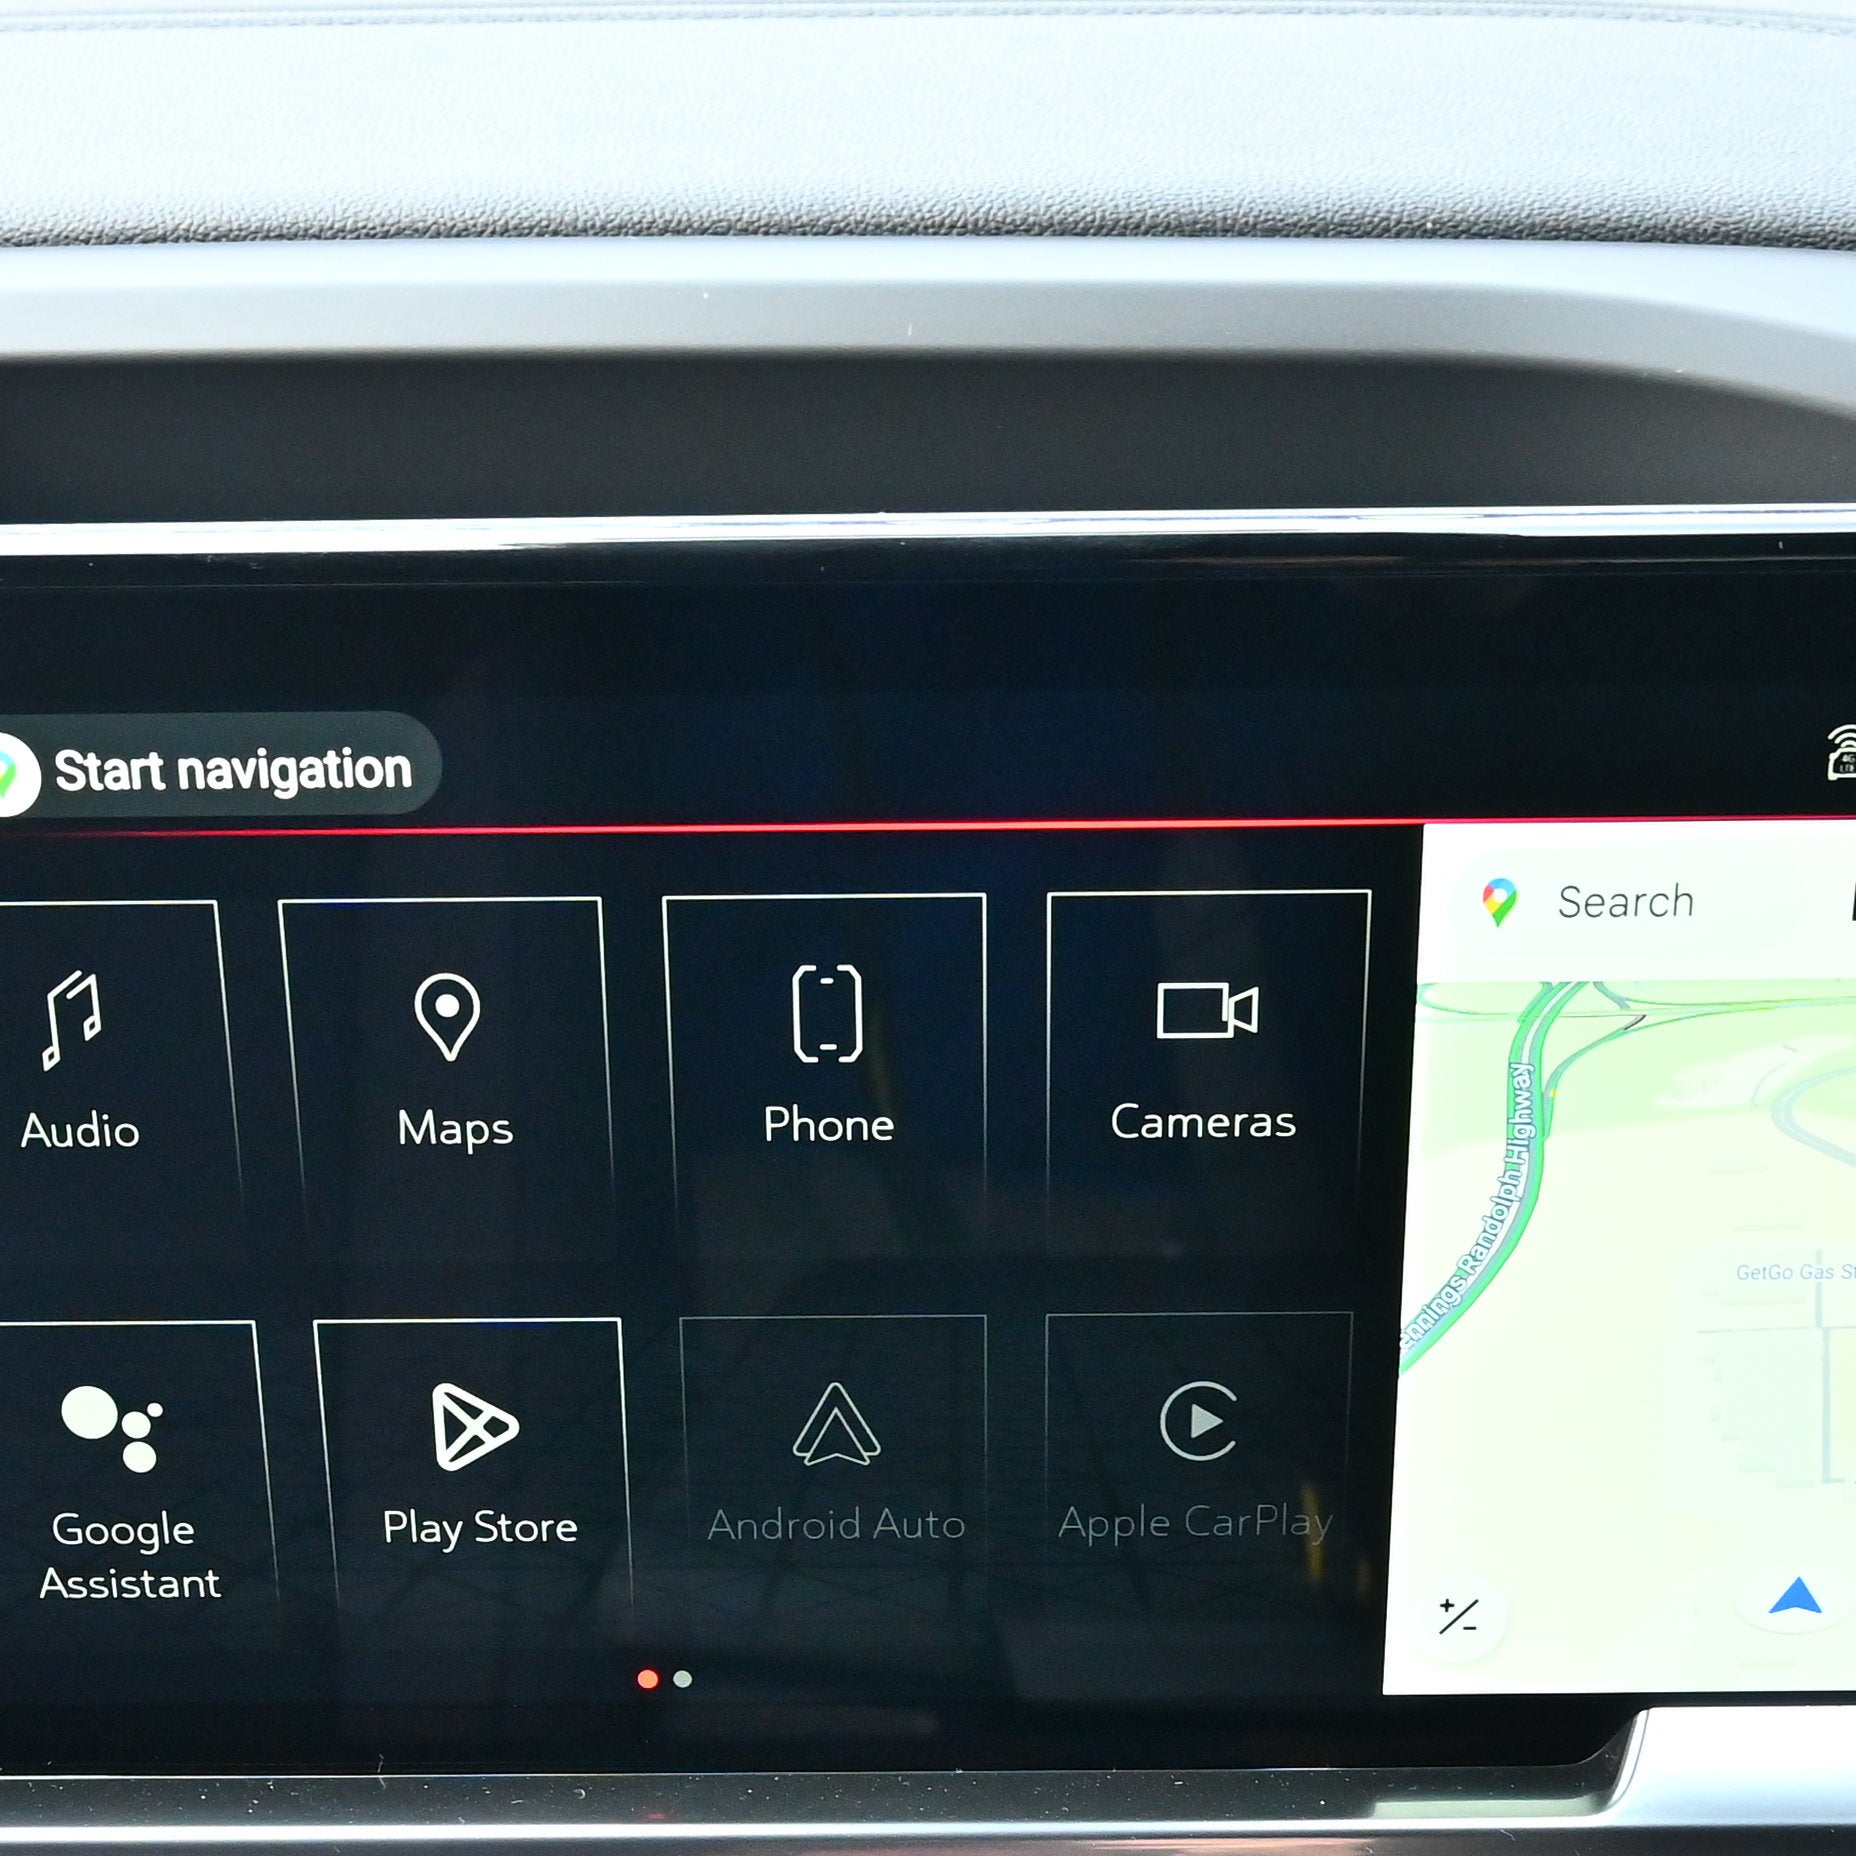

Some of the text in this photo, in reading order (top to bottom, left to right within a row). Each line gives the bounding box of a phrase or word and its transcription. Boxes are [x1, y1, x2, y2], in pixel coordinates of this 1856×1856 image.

[54, 746, 413, 800] Start navigation
[1558, 882, 1693, 919] Search
[20, 1109, 140, 1148] Audio
[398, 1108, 514, 1155] Maps
[765, 1103, 895, 1142] Phone
[1111, 1102, 1297, 1139] Cameras
[1456, 1170, 1522, 1275] Randolph
[1504, 1062, 1536, 1164] Highway
[1737, 1263, 1794, 1283] GetGo
[1800, 1263, 1835, 1281] Gas
[52, 1510, 195, 1556] Google
[384, 1508, 578, 1554] Play Store
[707, 1505, 967, 1543] Android Auto
[1058, 1503, 1335, 1548] Apple CarPlay
[39, 1566, 222, 1599] Assistant
